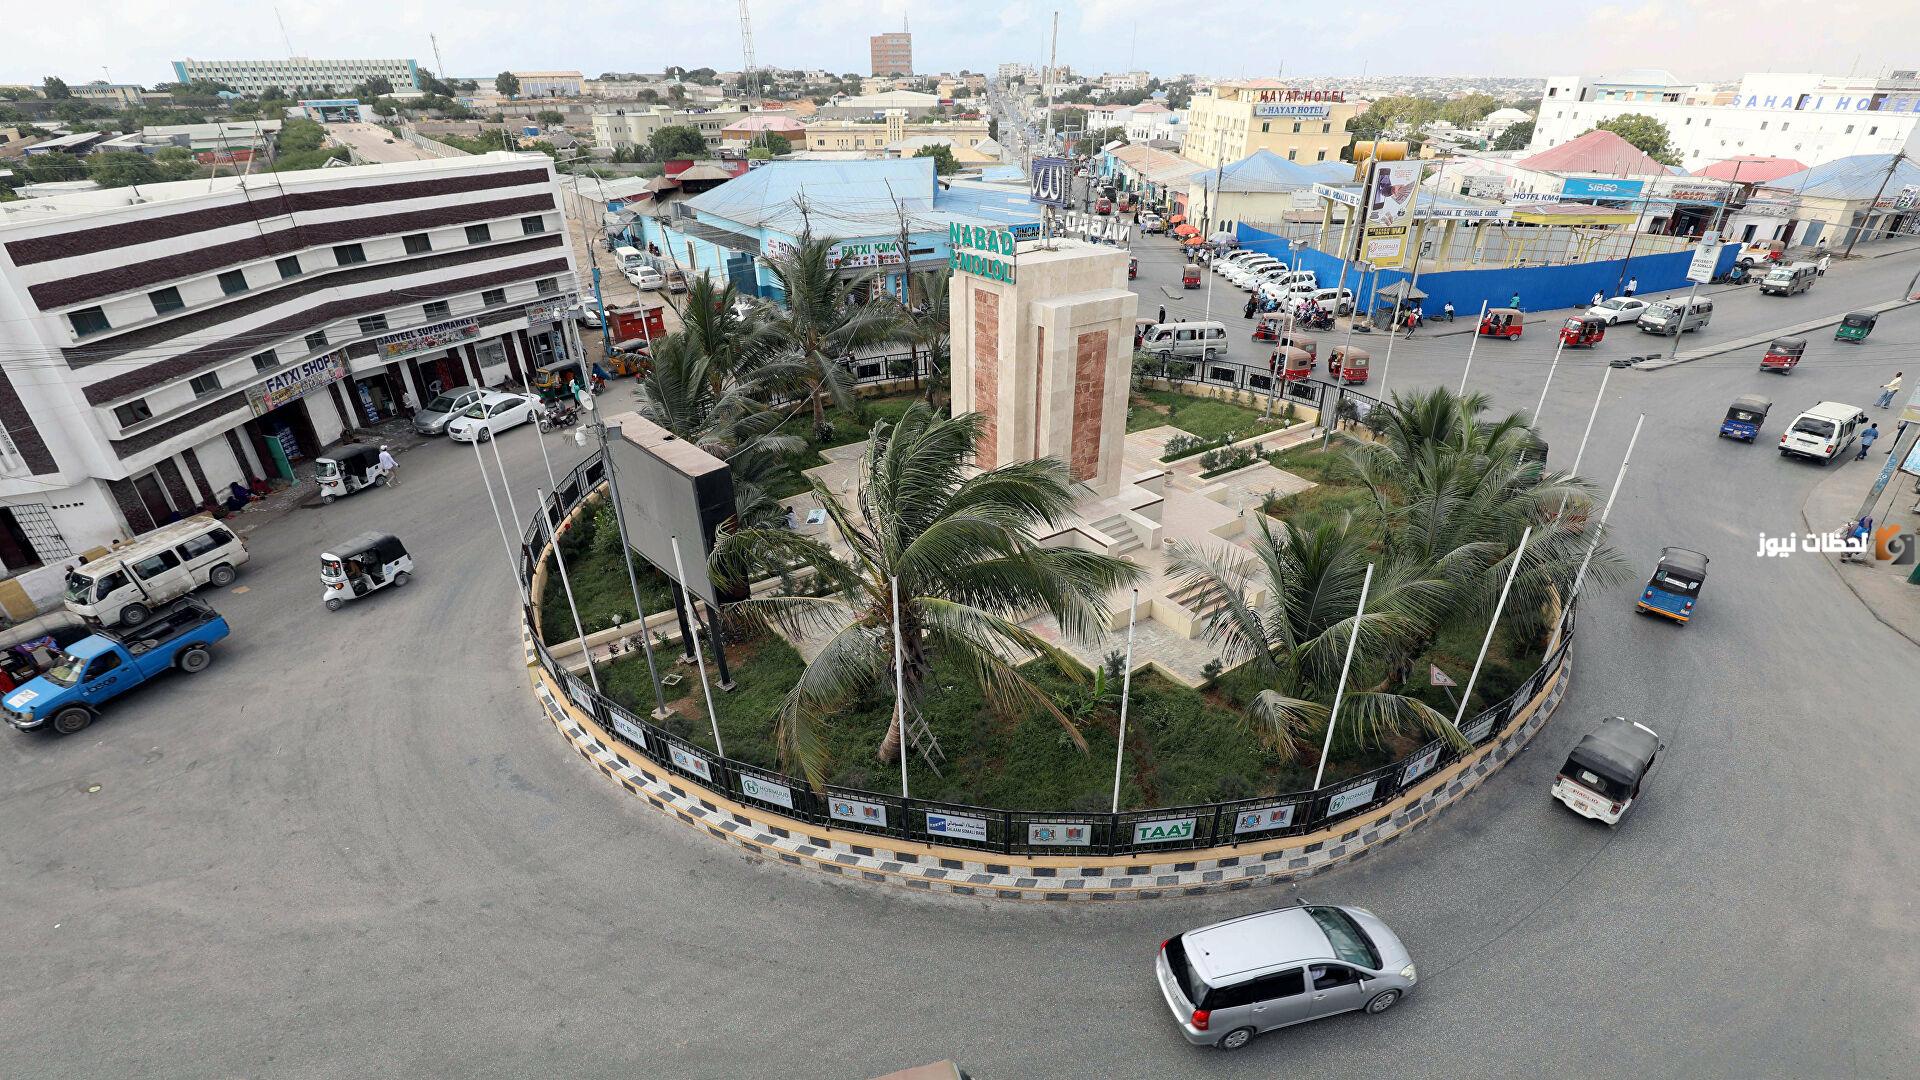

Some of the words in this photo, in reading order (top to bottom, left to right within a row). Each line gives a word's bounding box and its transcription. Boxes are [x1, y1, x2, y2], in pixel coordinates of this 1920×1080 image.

[1260, 90, 1299, 103] HAYAT
[1304, 90, 1346, 103] HOTEL
[1732, 94, 1824, 110] SAHAFI
[1268, 106, 1297, 114] HAYAT
[1297, 106, 1324, 114] HOTEL
[1541, 194, 1560, 202] KM4
[949, 221, 1016, 256] NABAD
[841, 244, 871, 256] FATXI
[874, 242, 897, 254] KM4
[960, 254, 1016, 285] NOLOL
[376, 330, 416, 345] DARYEEL
[418, 317, 475, 337] SUPERMARKET
[266, 368, 302, 393] FATXI
[302, 354, 331, 378] SHOP
[760, 785, 789, 799] HORMUUD
[1138, 824, 1191, 839] TAAJ
